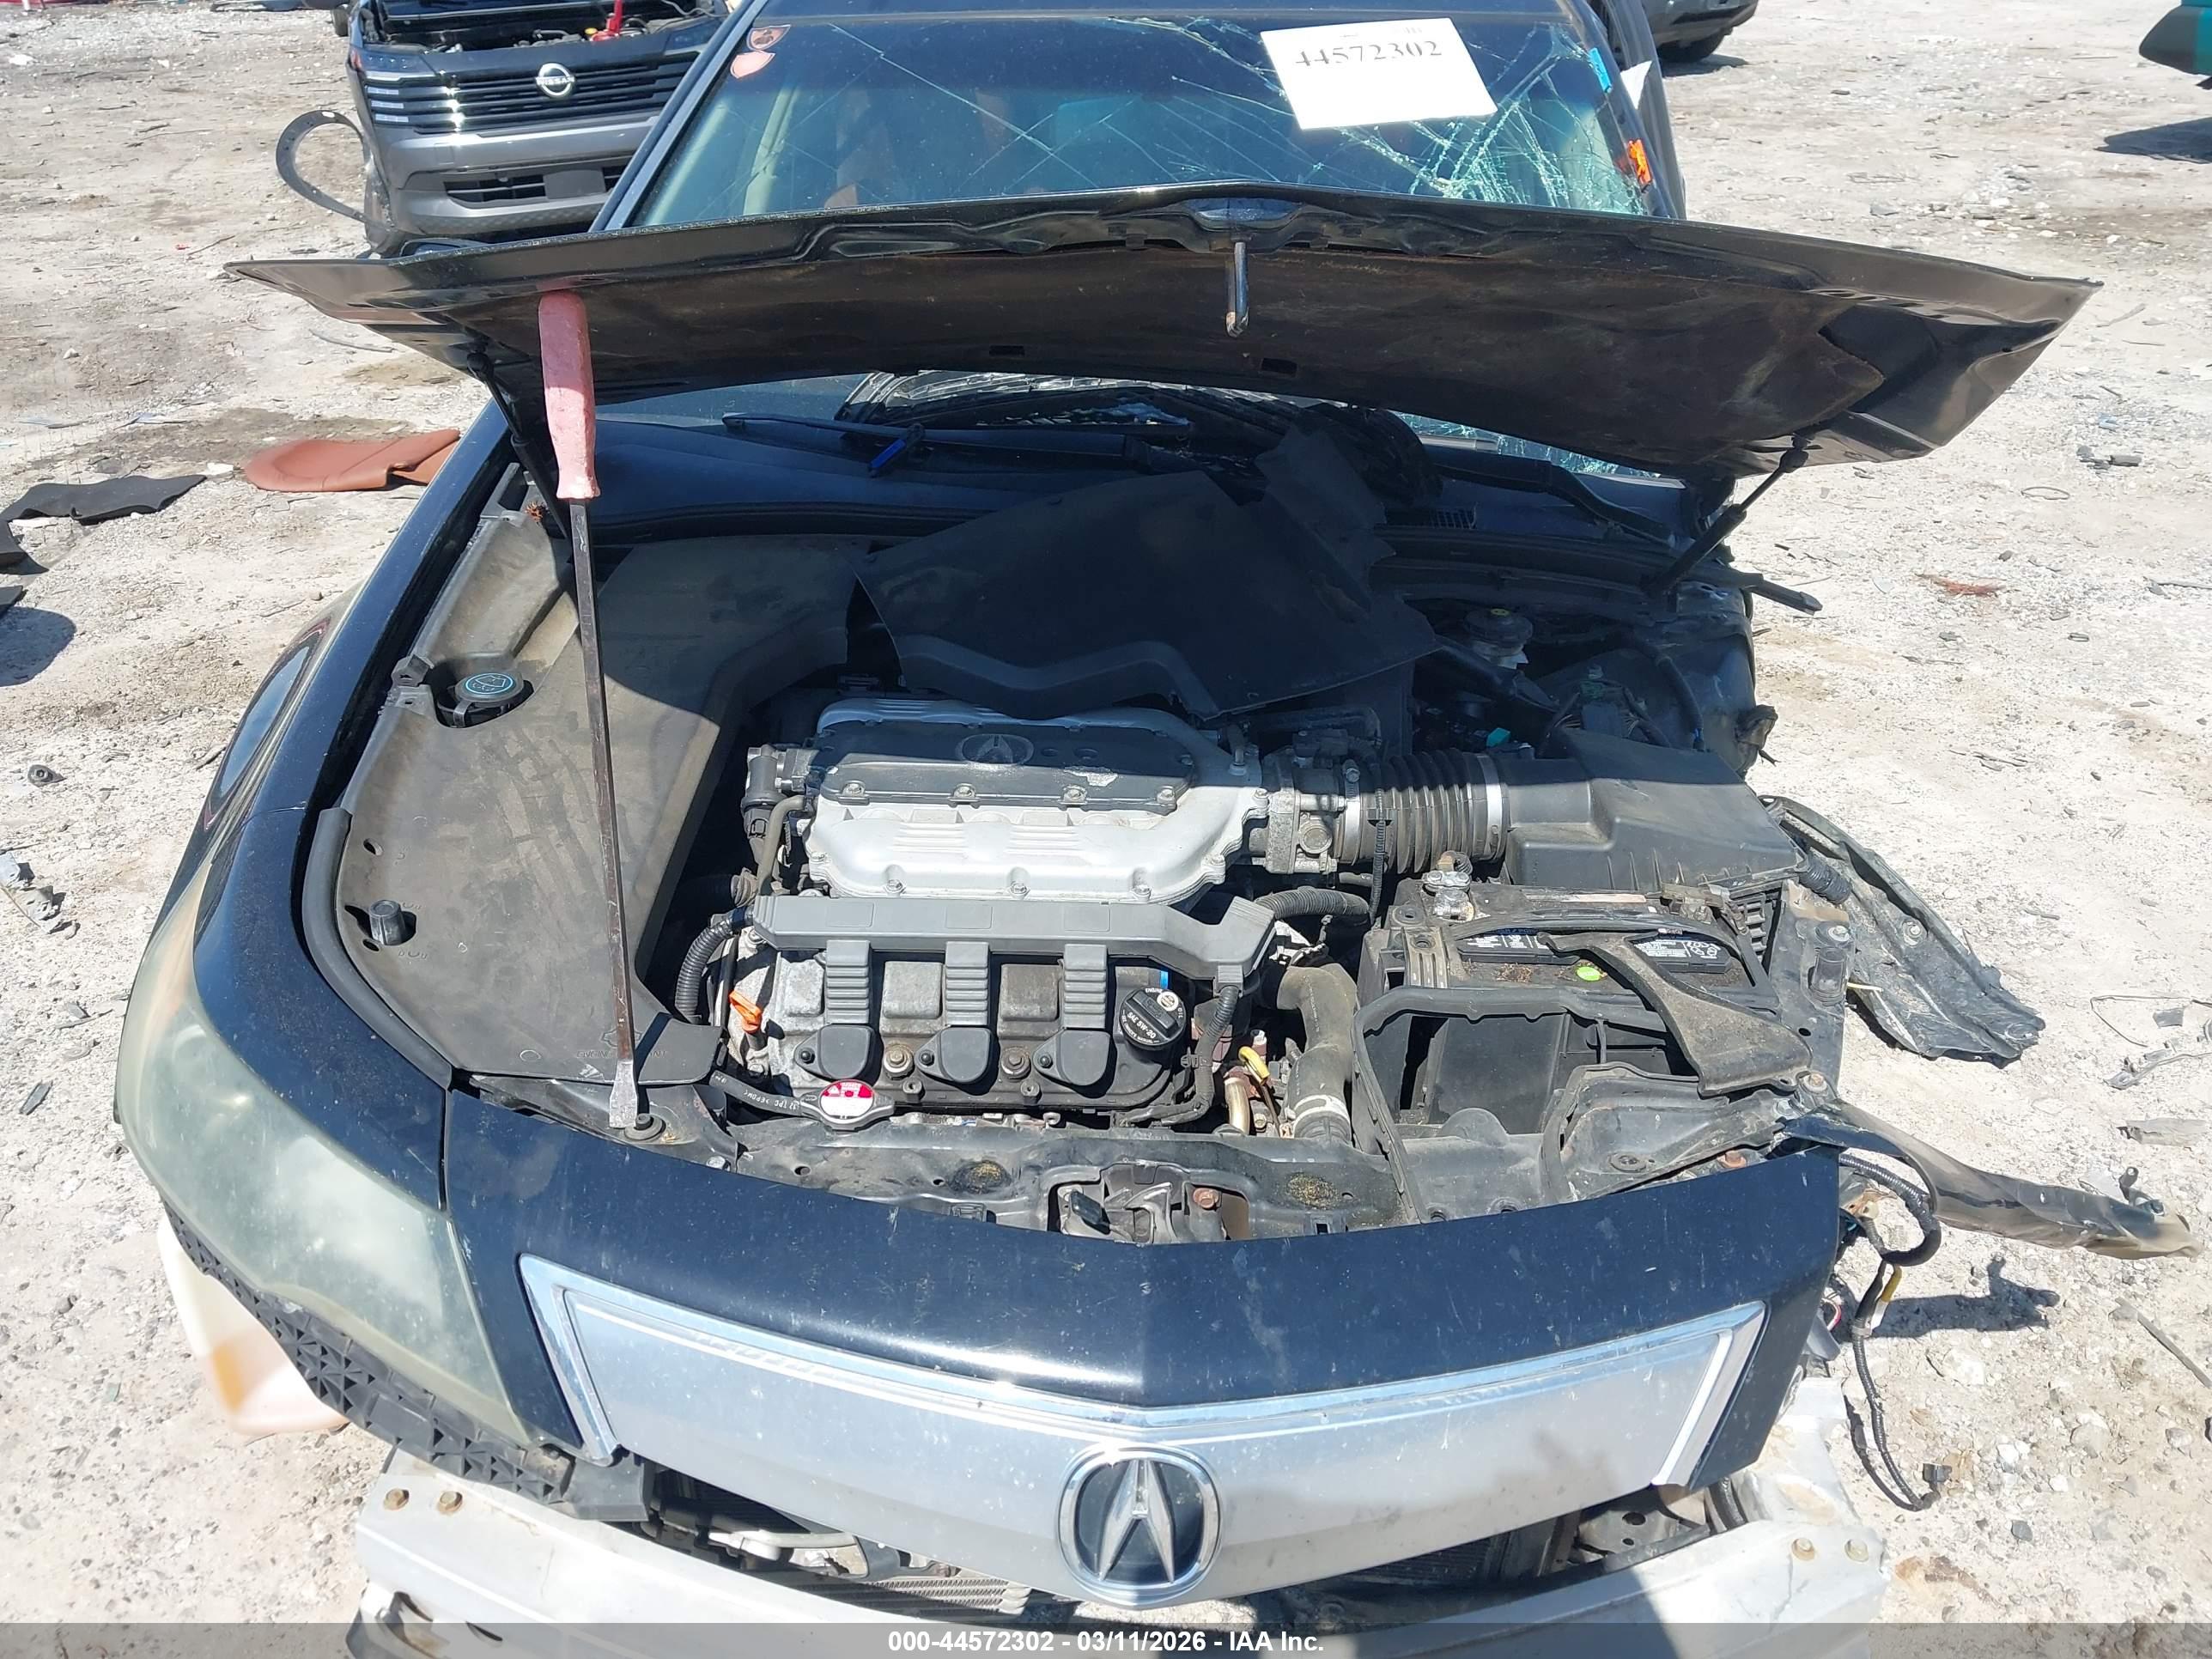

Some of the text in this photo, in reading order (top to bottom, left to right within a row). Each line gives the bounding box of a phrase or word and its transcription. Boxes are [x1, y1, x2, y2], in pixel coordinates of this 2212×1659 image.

[1295, 40, 1443, 67] 44572302
[1127, 1012, 1157, 1039] SAE 5W-20
